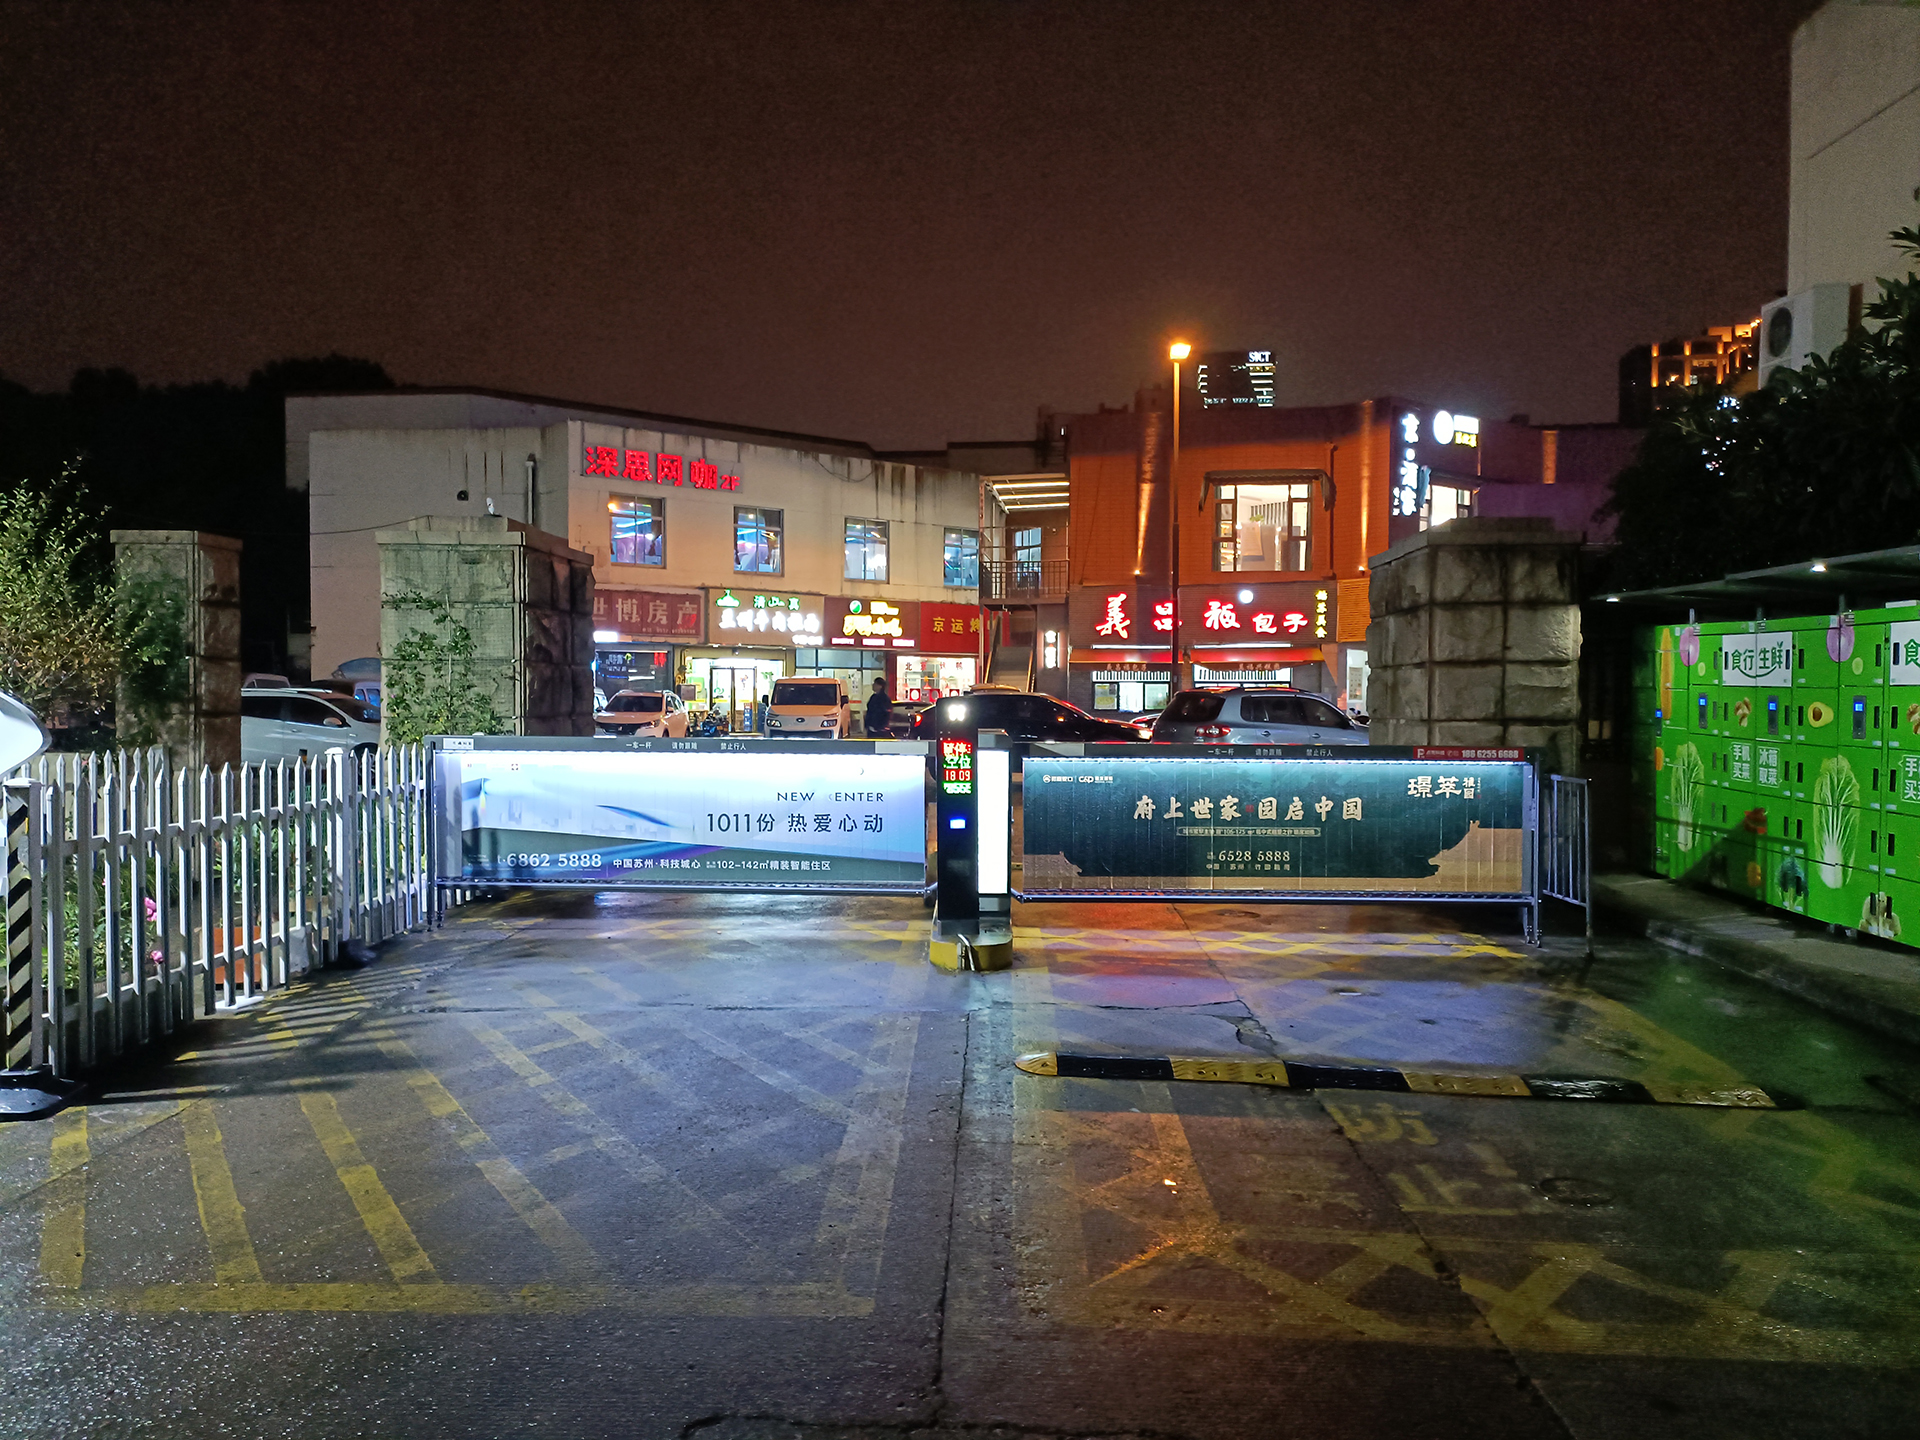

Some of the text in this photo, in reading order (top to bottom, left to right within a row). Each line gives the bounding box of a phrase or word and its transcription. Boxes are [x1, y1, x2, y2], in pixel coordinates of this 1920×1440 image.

[585, 446, 740, 491] 深思网咖 2F
[593, 597, 697, 625] 世博房产
[932, 616, 998, 634] 京运烤
[1731, 641, 1783, 671] 食行生鲜
[720, 742, 747, 751] 禁止行人
[1733, 744, 1750, 761] 手机
[1759, 748, 1778, 766] 冰箱
[1733, 761, 1750, 779] 买菜
[1759, 767, 1778, 785] 取菜
[1905, 757, 1920, 777] 手
[777, 792, 815, 801] NEW
[1904, 779, 1920, 800] 买
[1133, 795, 1362, 822] 府上世家 园启中国
[707, 813, 883, 833] 1011份 热爱心动
[557, 853, 601, 867] 5888
[1218, 850, 1251, 862] 6528
[1257, 850, 1290, 862] 5888
